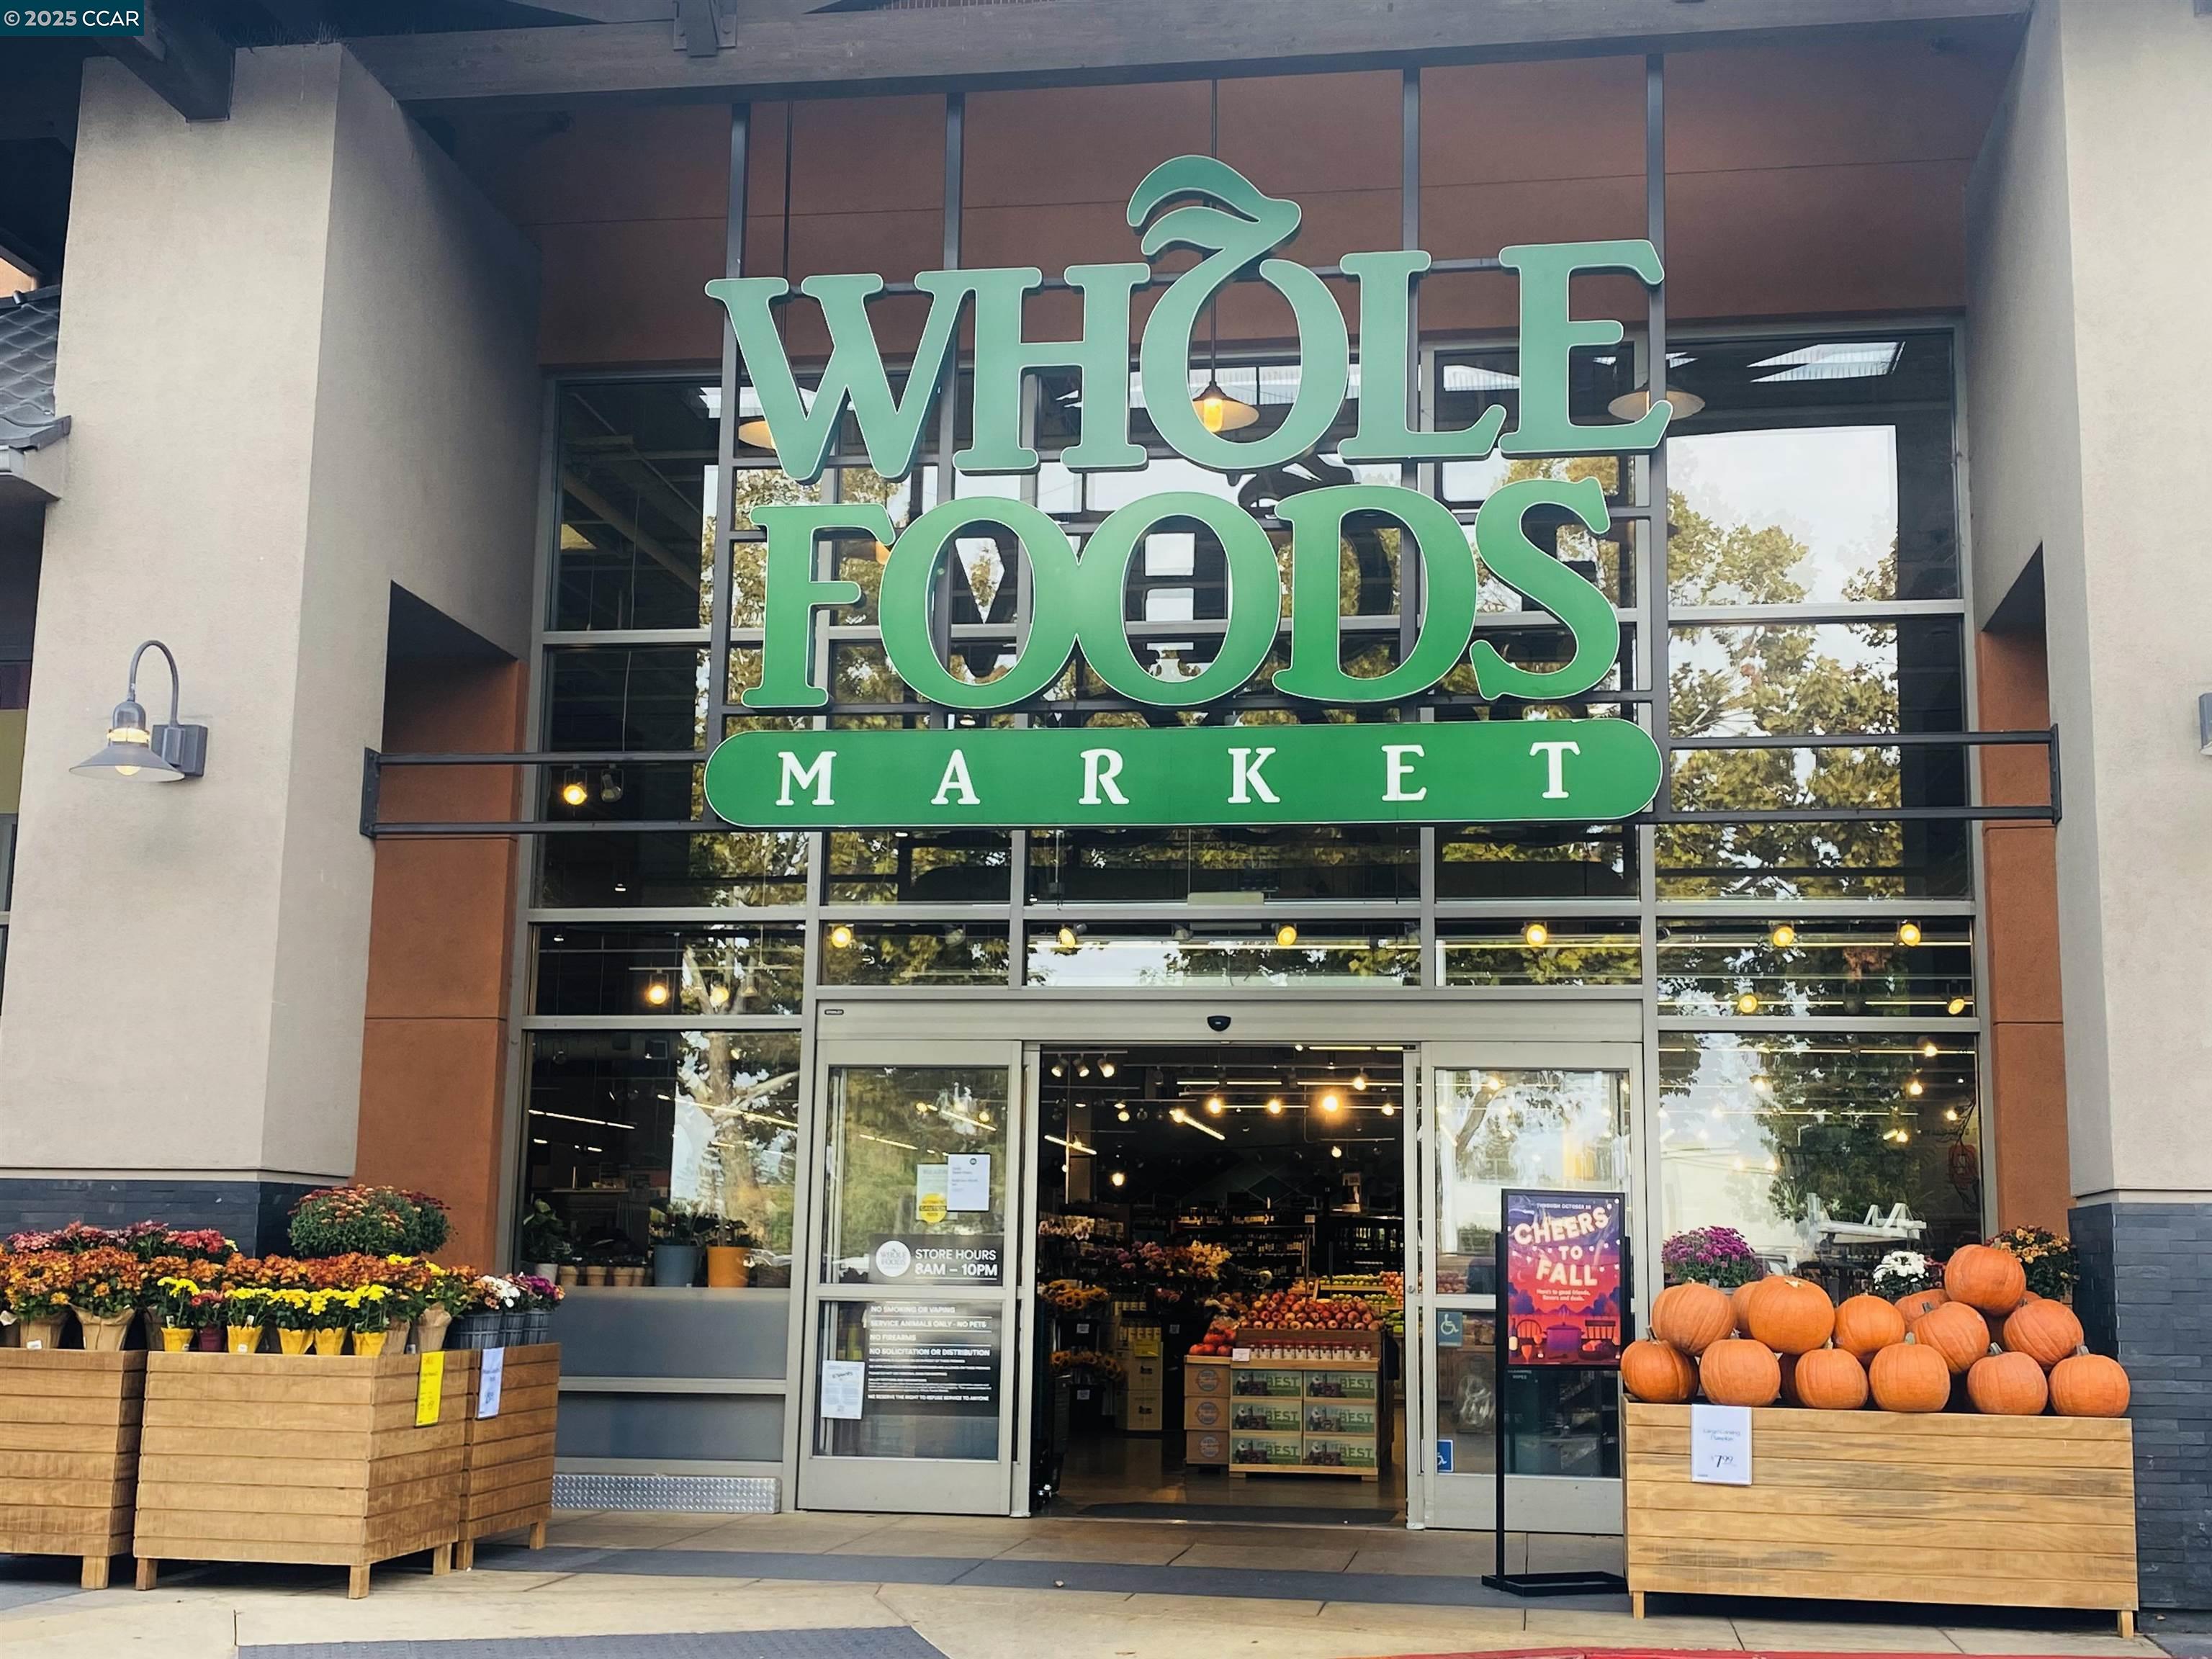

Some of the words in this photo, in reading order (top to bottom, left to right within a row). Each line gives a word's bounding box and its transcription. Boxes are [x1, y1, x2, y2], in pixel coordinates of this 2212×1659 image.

[705, 238, 1674, 484] WHOLE
[741, 477, 1621, 709] FOODS
[774, 739, 1582, 807] MARKET
[1514, 1207, 1610, 1245] CHEERS
[881, 1248, 906, 1257] WHOLE
[915, 1249, 953, 1259] STORE
[956, 1249, 997, 1260] HOURS
[1558, 1245, 1583, 1260] TO
[914, 1263, 945, 1275] 8AM
[961, 1264, 998, 1276] 10PM
[1536, 1257, 1598, 1287] FALL
[1267, 1376, 1299, 1388] BEST
[1339, 1377, 1373, 1389] BEST
[1266, 1411, 1298, 1422] BEST
[1339, 1412, 1373, 1424] BEST
[1266, 1445, 1298, 1457] BEST
[1340, 1447, 1373, 1459] BEST
